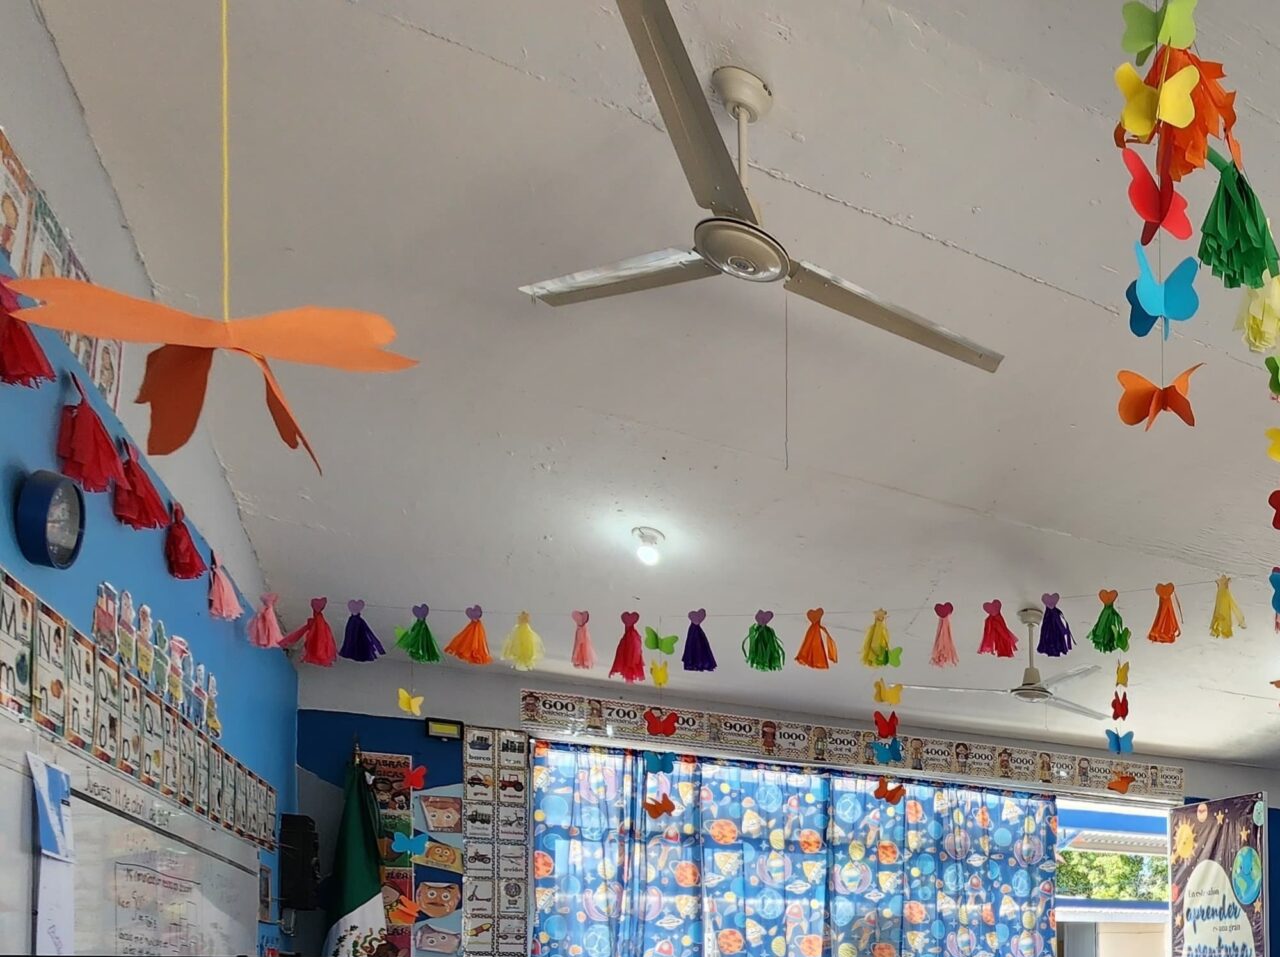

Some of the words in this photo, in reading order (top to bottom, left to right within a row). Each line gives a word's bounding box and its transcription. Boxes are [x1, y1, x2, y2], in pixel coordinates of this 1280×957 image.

[1, 591, 17, 640] M
[38, 618, 52, 662] N
[40, 686, 48, 715] n
[123, 684, 130, 720] P
[541, 701, 576, 713] 600
[606, 707, 638, 720] 700
[144, 704, 154, 736] Q
[723, 721, 753, 733] 900
[777, 731, 806, 742] 1000
[828, 737, 857, 747] 2000
[468, 753, 491, 761] barco
[923, 748, 950, 758] 4000
[968, 752, 994, 762] 5000
[360, 756, 410, 769] ALABRAS
[1010, 756, 1034, 766] 6000
[1051, 761, 1074, 771] 7000
[1088, 766, 1112, 775] 8000
[1160, 773, 1180, 781] 10000
[1186, 894, 1241, 934] aprender
